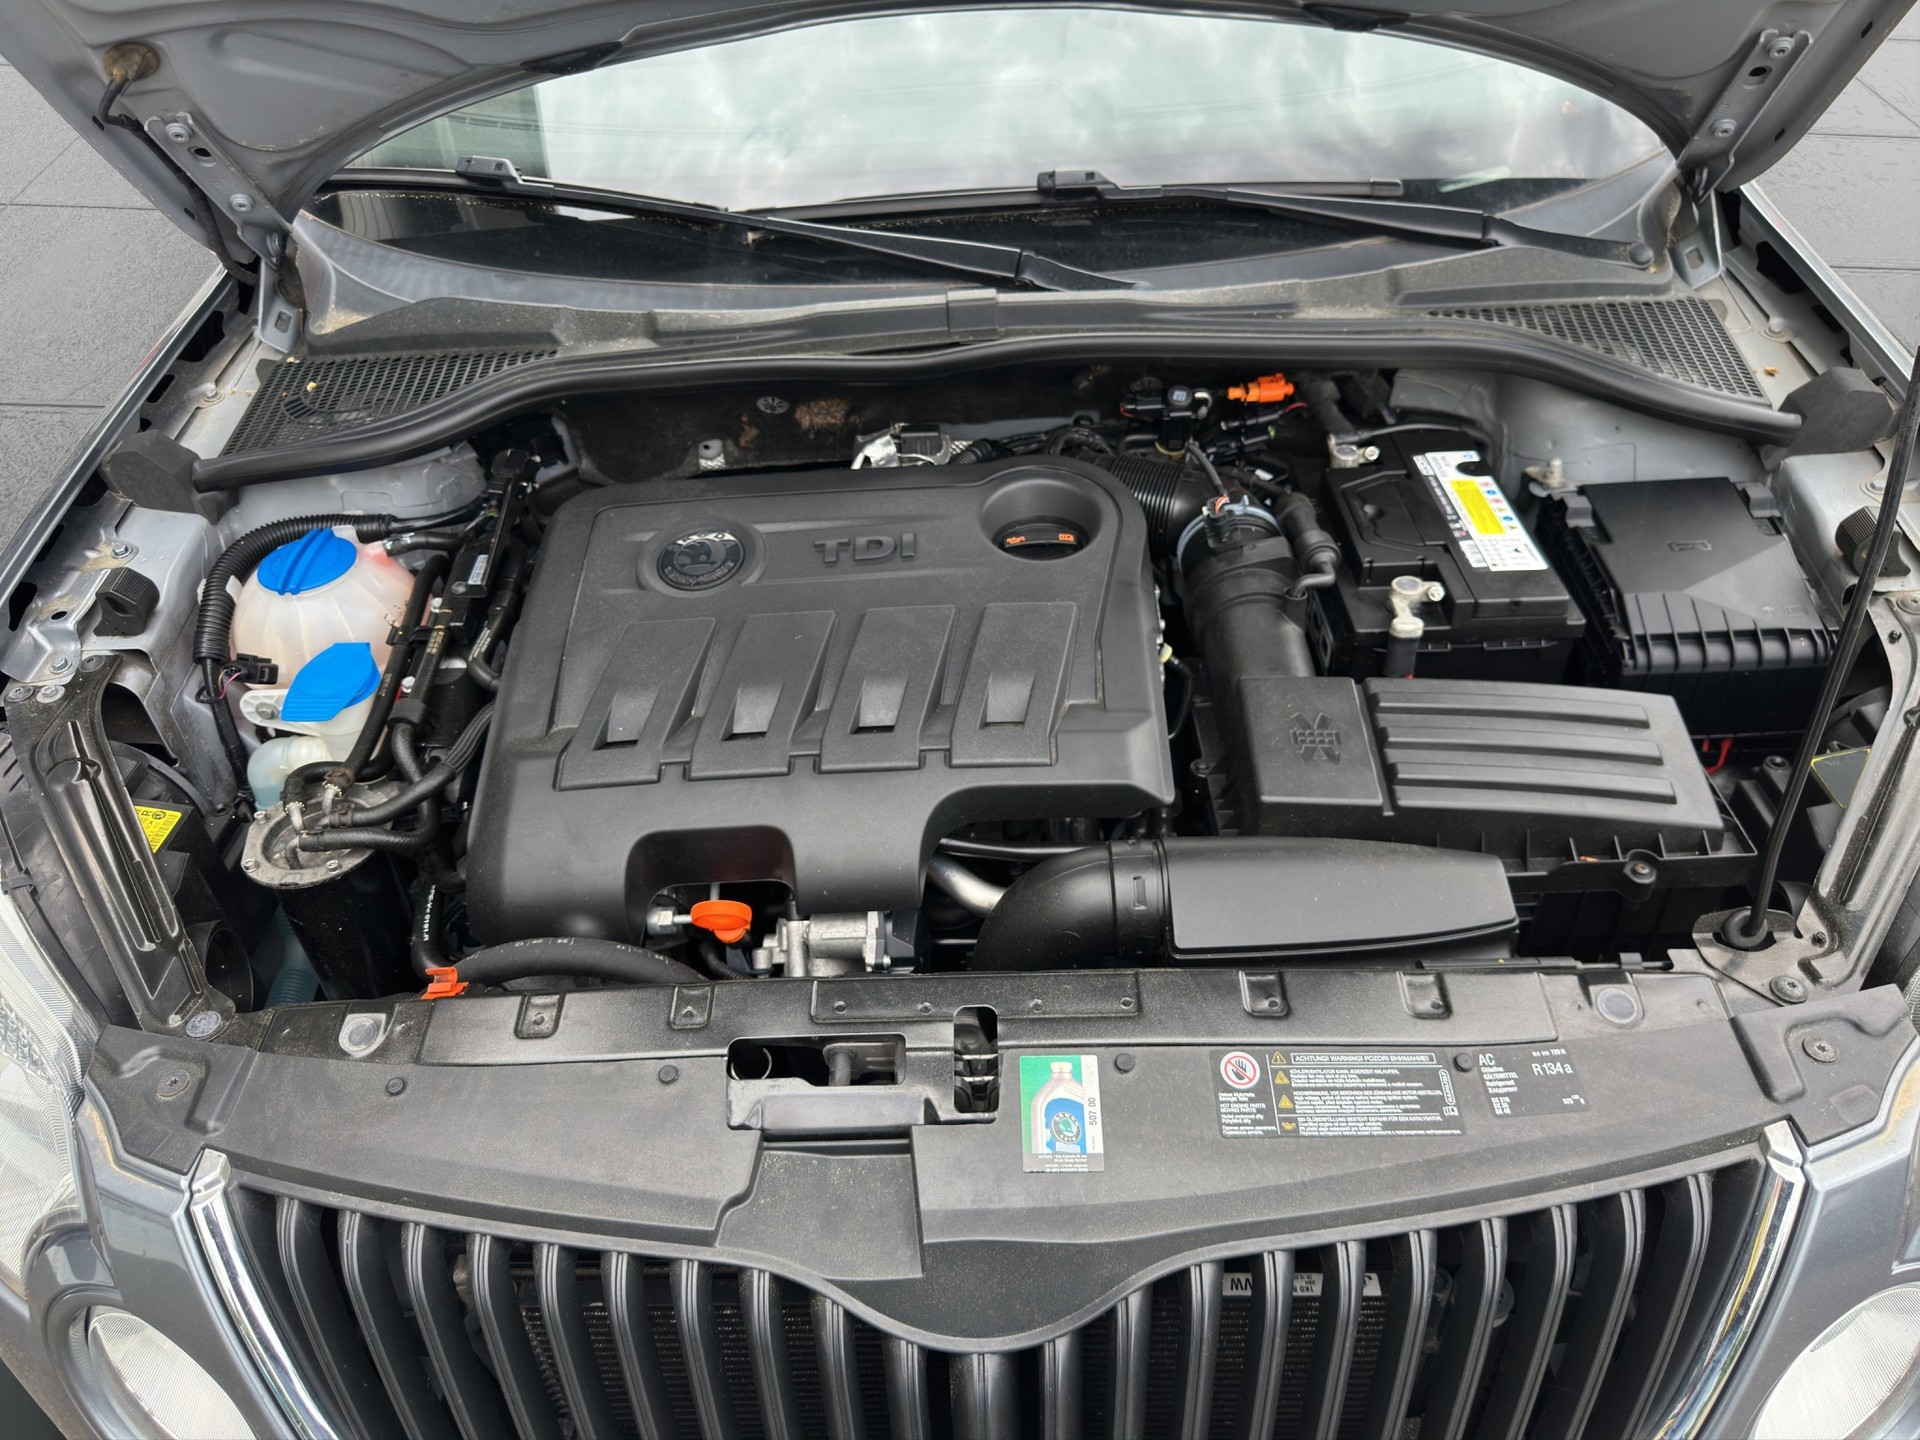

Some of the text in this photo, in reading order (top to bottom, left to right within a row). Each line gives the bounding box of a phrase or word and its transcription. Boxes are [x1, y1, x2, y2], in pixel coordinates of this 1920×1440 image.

[814, 532, 915, 565] TDI
[1479, 1053, 1495, 1066] AC
[1087, 1097, 1096, 1107] 00
[1088, 1111, 1097, 1126] 507
